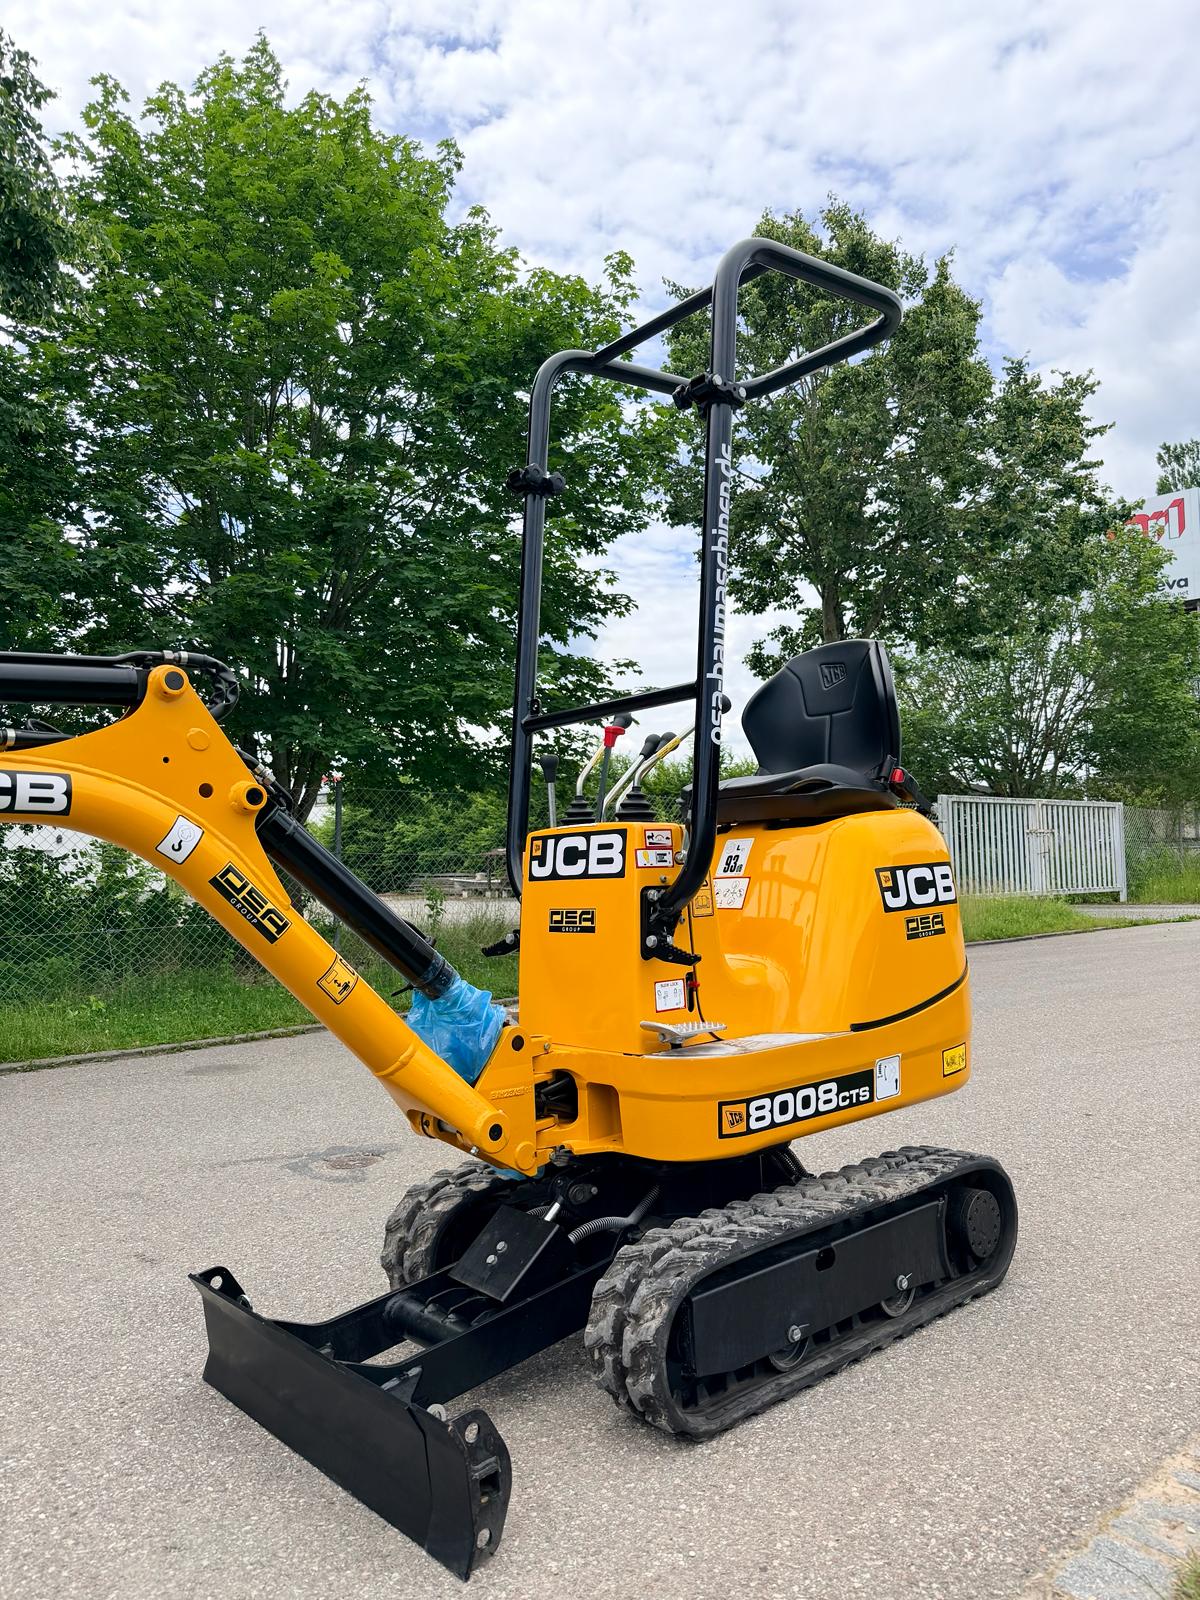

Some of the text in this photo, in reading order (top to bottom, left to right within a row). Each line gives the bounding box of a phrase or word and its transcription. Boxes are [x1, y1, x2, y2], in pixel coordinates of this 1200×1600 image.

[707, 443, 732, 746] osa-baumaschinende
[0, 772, 68, 812] B
[531, 833, 624, 877] JCB
[883, 865, 956, 908] JCB
[230, 897, 258, 924] GROUP
[729, 1112, 744, 1127] JCB
